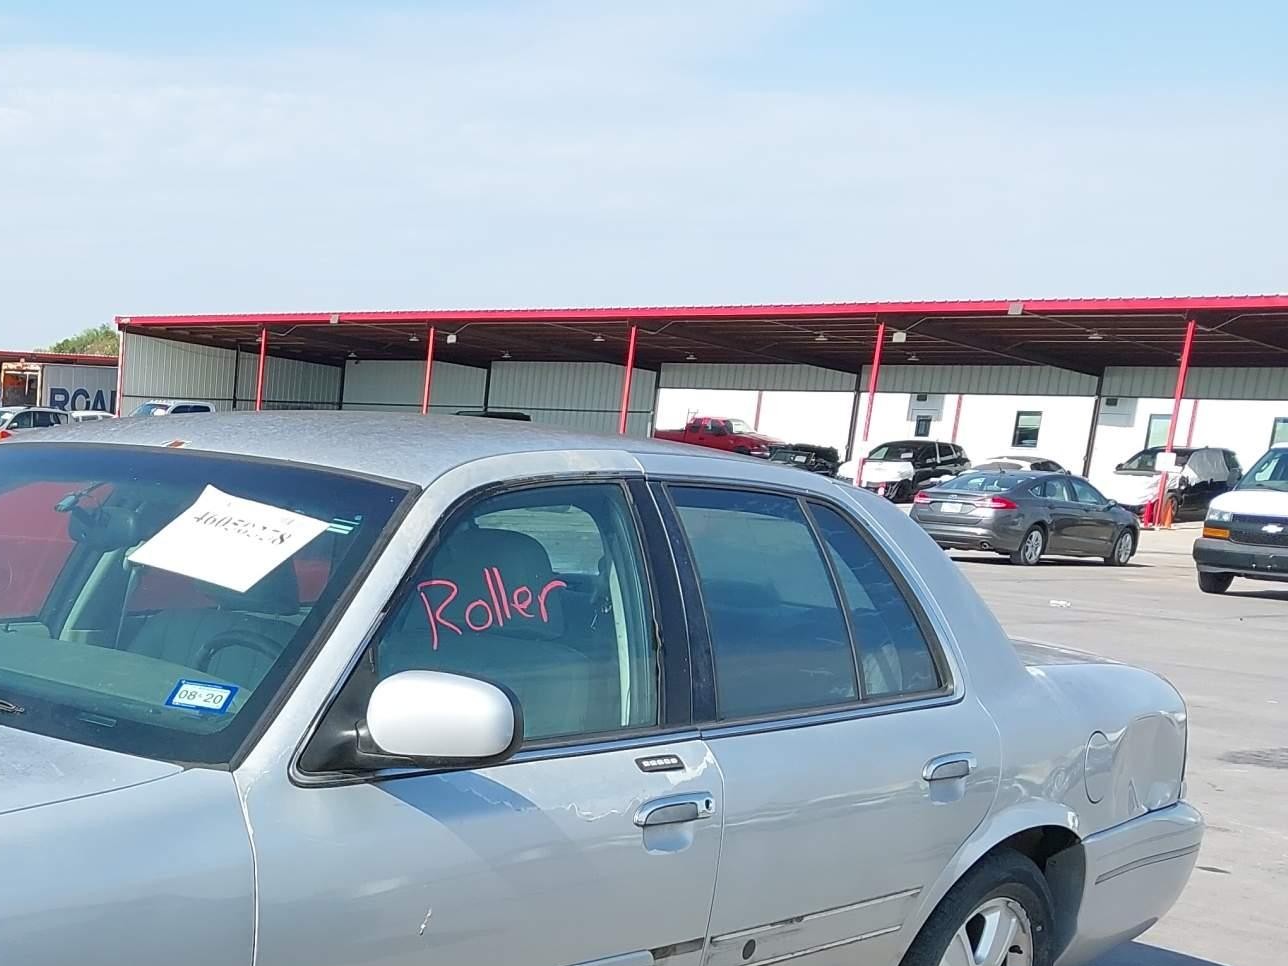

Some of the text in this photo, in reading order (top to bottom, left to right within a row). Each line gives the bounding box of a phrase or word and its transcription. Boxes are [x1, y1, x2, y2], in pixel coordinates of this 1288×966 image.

[416, 566, 568, 651] Roller
[178, 689, 224, 705] 08 20
